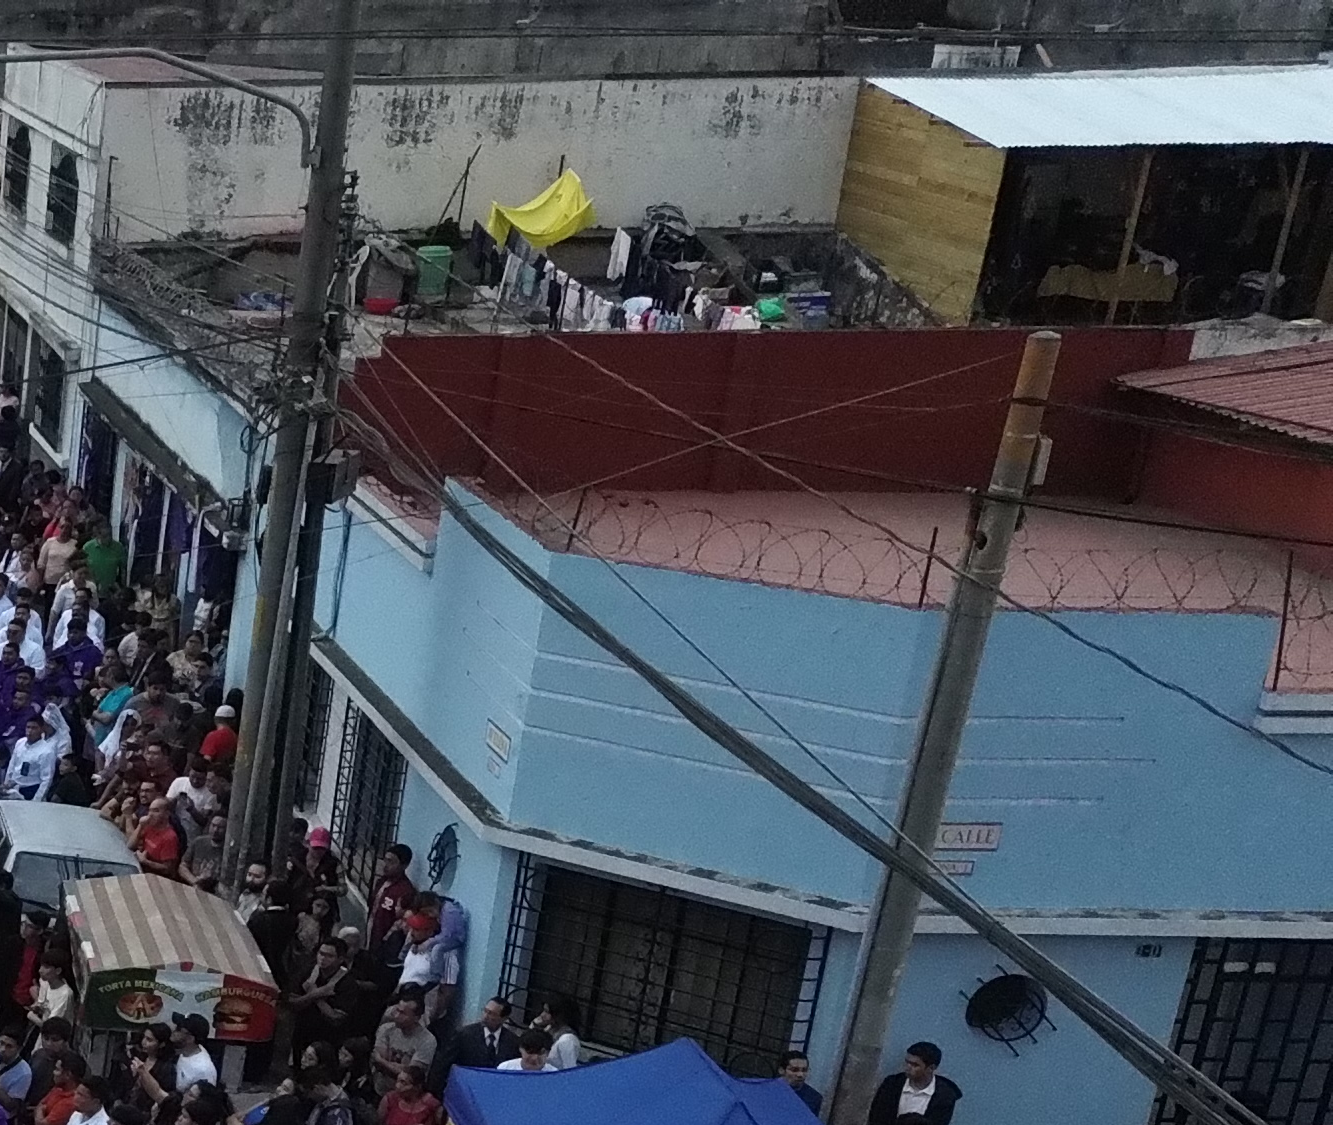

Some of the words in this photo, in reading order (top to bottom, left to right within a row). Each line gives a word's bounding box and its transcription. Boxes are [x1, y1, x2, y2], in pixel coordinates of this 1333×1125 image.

[941, 829, 994, 844] CALLE
[98, 982, 132, 994] TORTA
[134, 980, 185, 1003] MEXICANA
